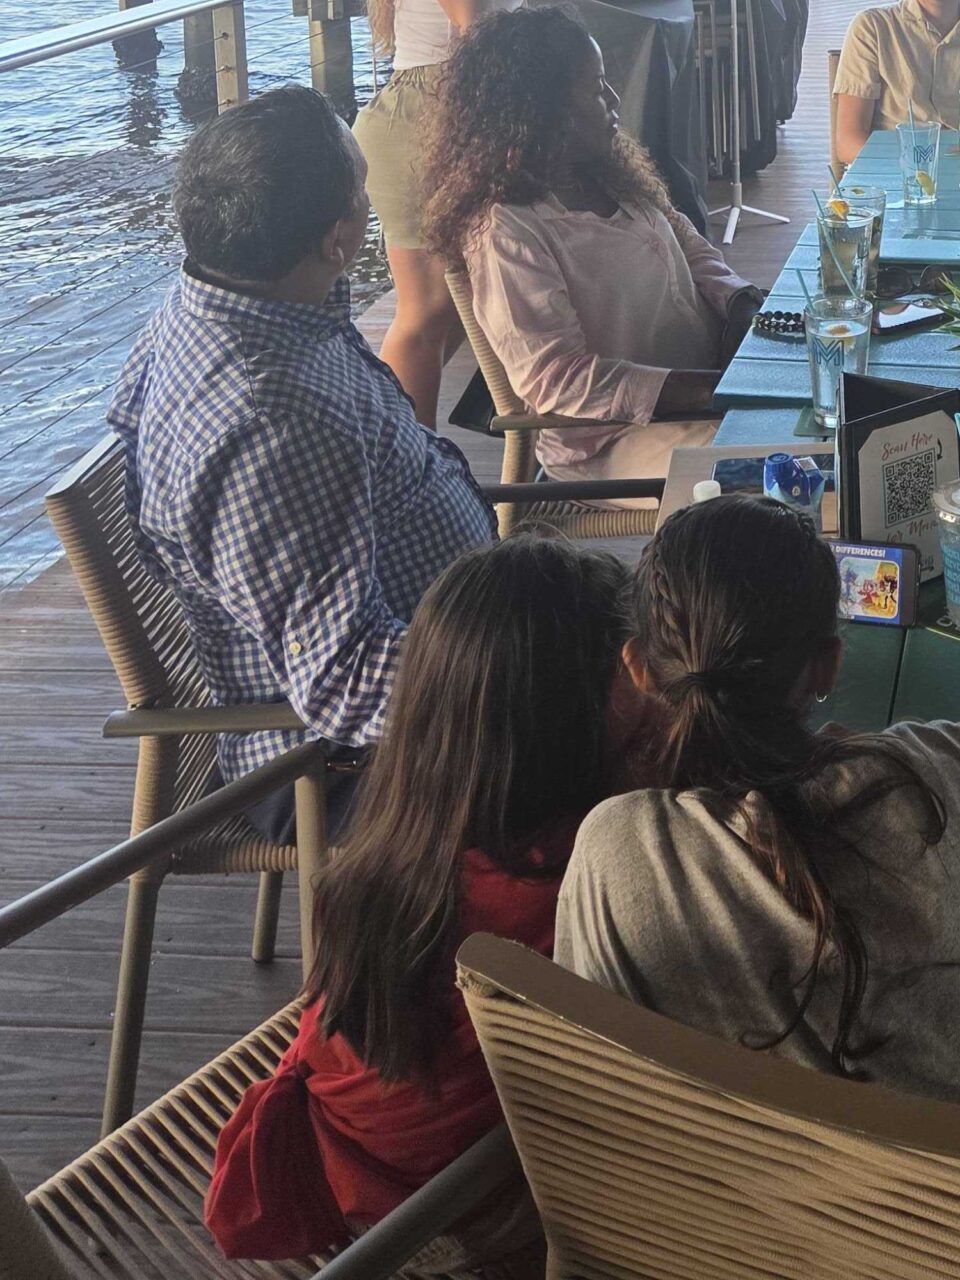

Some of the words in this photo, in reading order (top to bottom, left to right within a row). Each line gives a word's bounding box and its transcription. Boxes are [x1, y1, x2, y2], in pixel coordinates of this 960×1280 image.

[814, 336, 845, 367] M
[881, 441, 908, 461] Scan
[911, 431, 933, 451] Here
[835, 545, 886, 558] DIFFERENCES!
